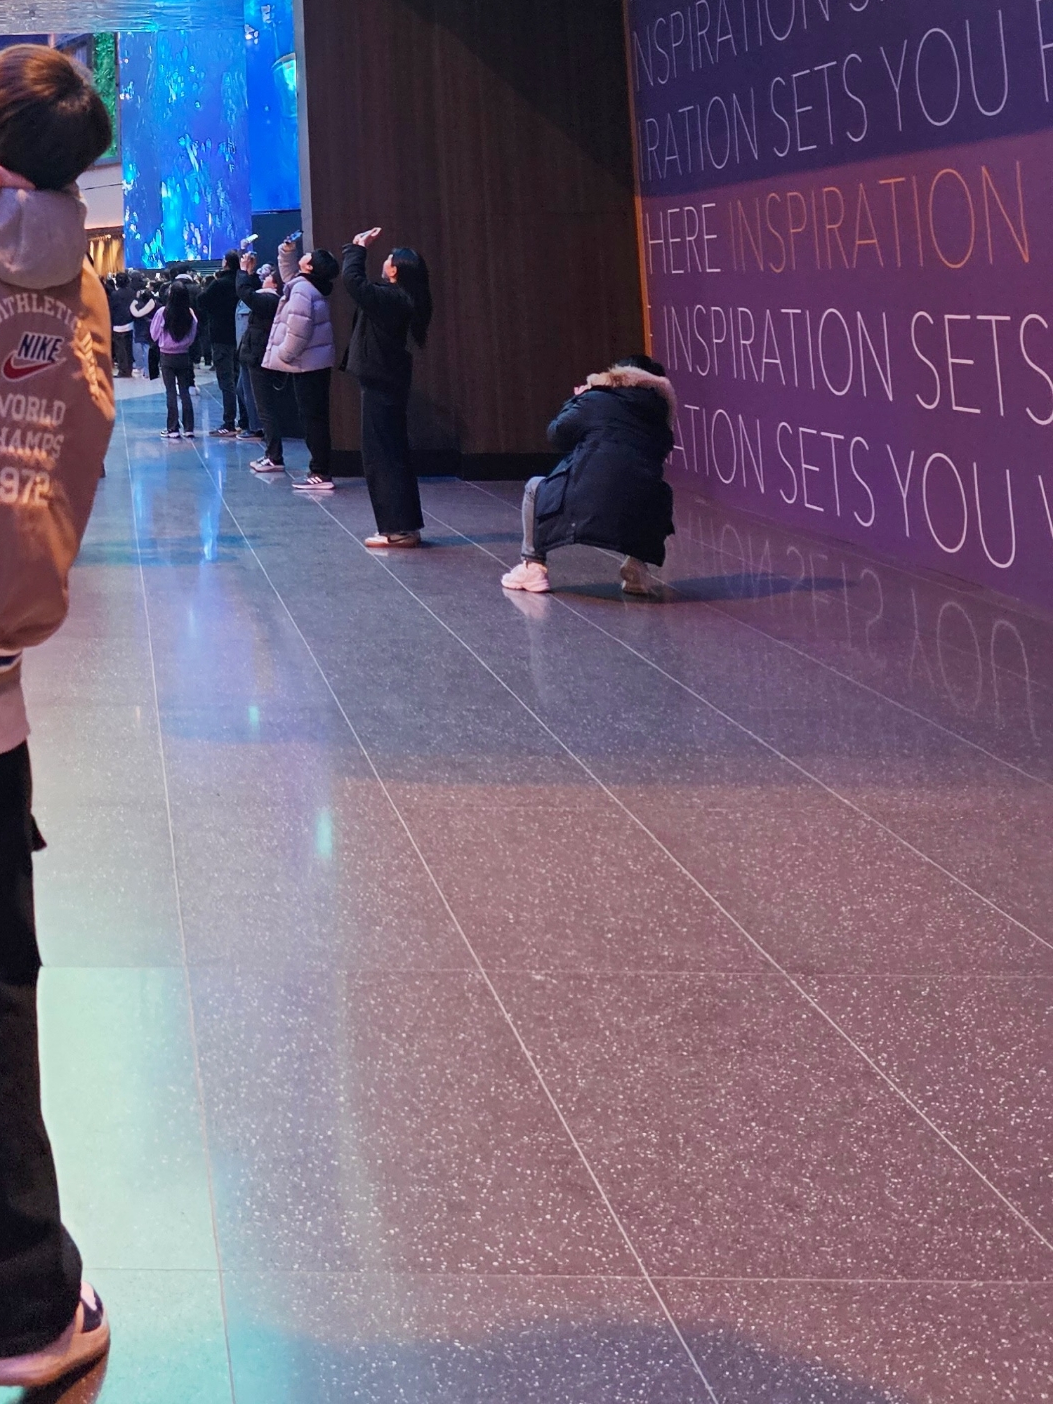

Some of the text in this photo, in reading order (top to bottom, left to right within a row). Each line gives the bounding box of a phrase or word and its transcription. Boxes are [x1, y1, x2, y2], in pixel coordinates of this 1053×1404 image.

[770, 53, 868, 157] SETS
[880, 9, 1009, 132] YOU
[646, 160, 1031, 275] HERE INSPIRATION
[16, 332, 64, 364] NIKE
[663, 304, 1053, 426] INSPIRATION SETS
[665, 403, 766, 495] ATION
[776, 421, 876, 527] SETS
[886, 444, 1016, 569] YOU
